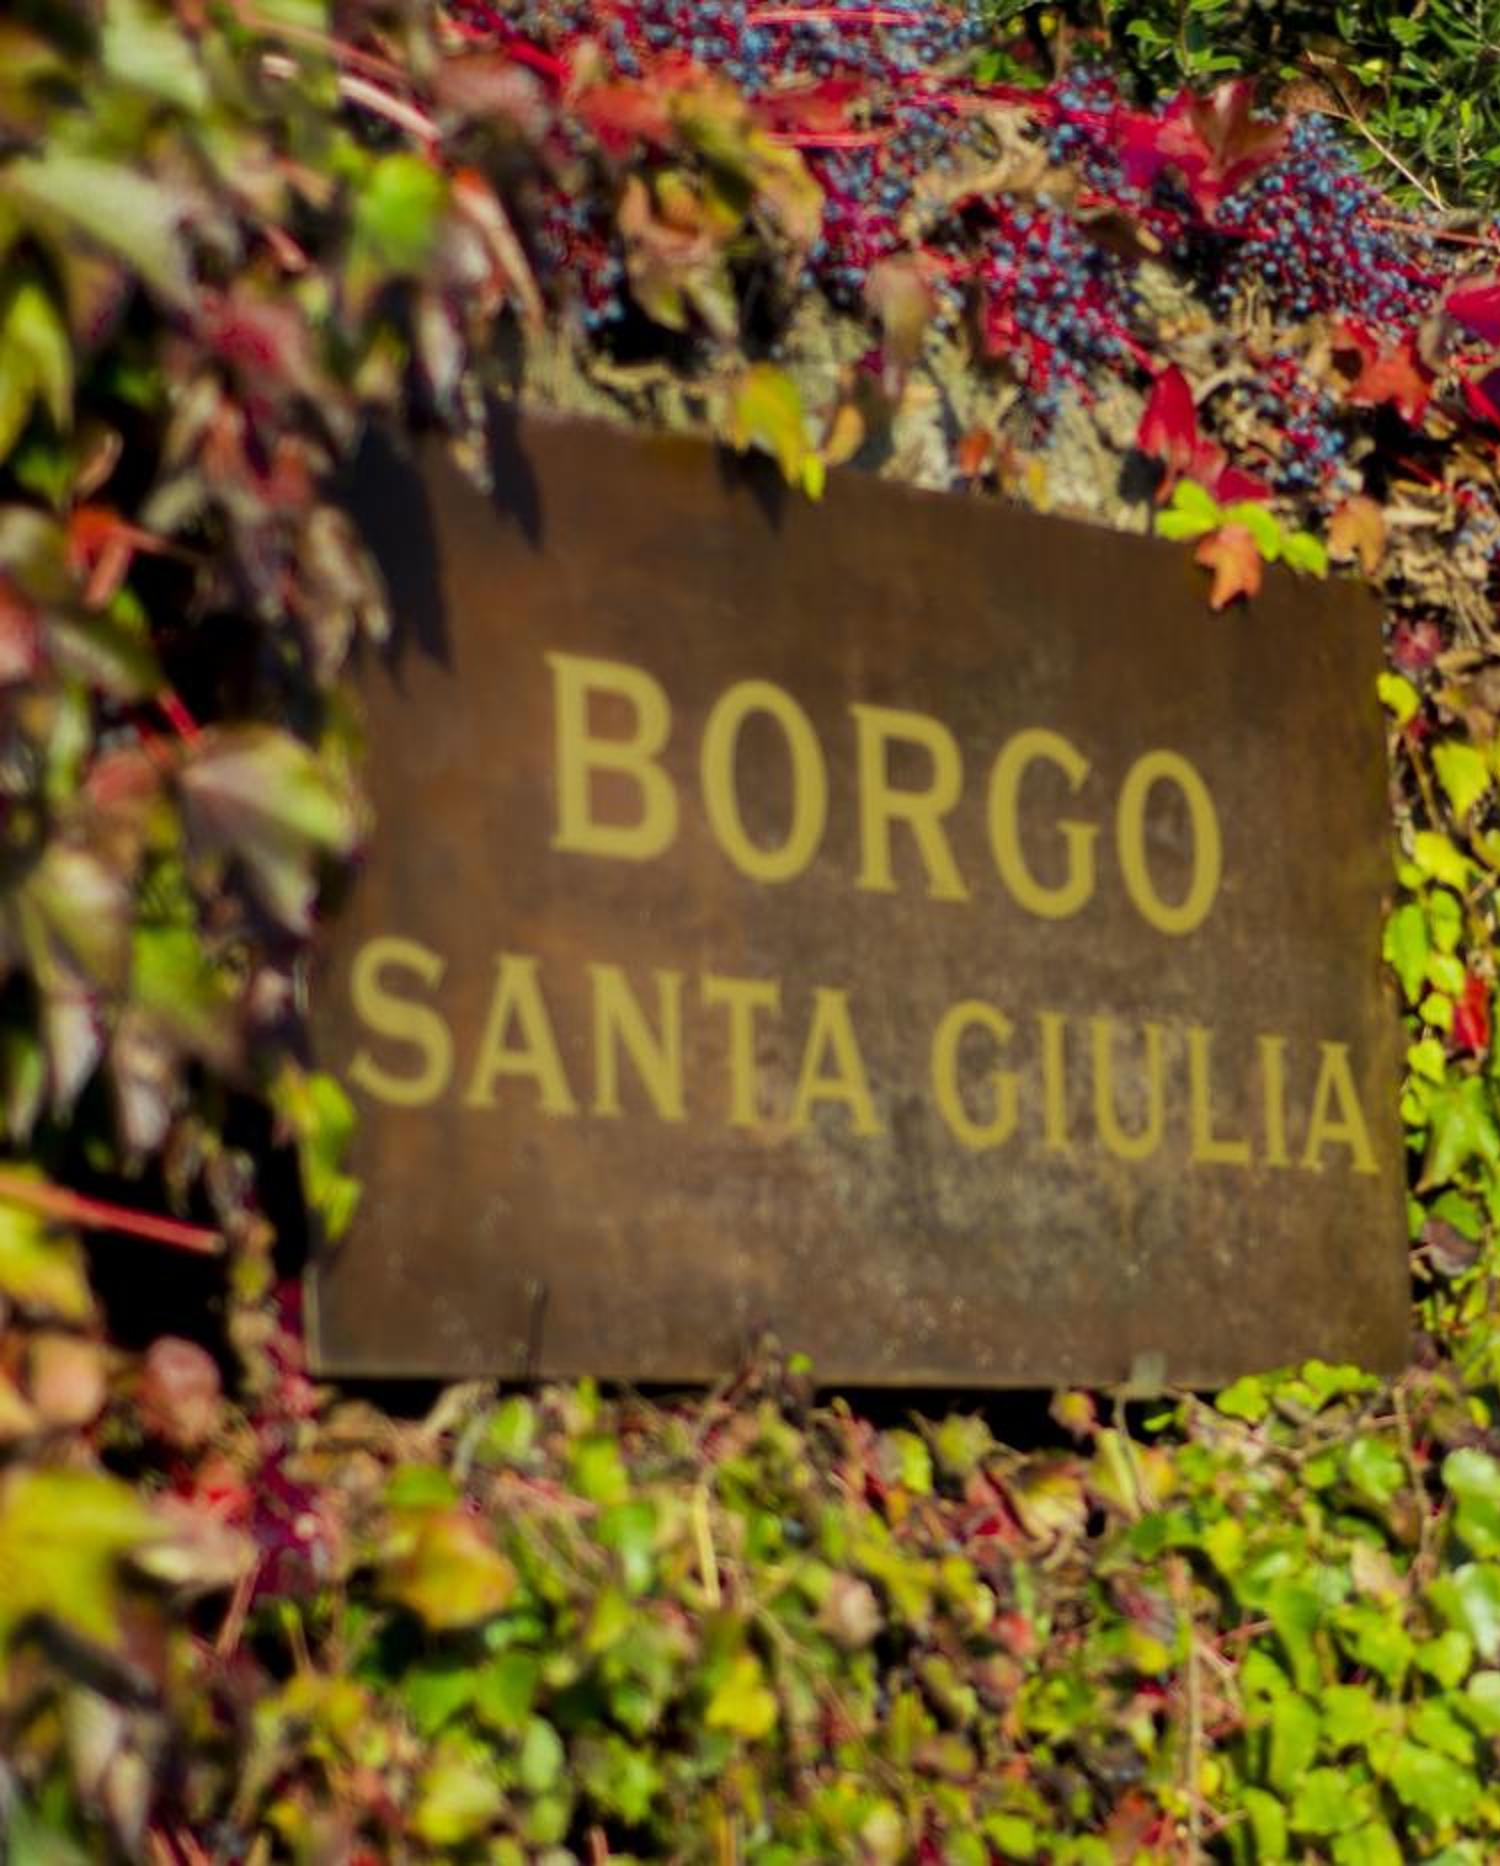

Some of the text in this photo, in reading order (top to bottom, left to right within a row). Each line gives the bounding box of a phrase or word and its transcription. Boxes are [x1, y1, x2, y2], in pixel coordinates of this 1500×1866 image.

[544, 651, 1223, 936] BORGO
[347, 936, 1381, 1174] SANTA GIULIA
